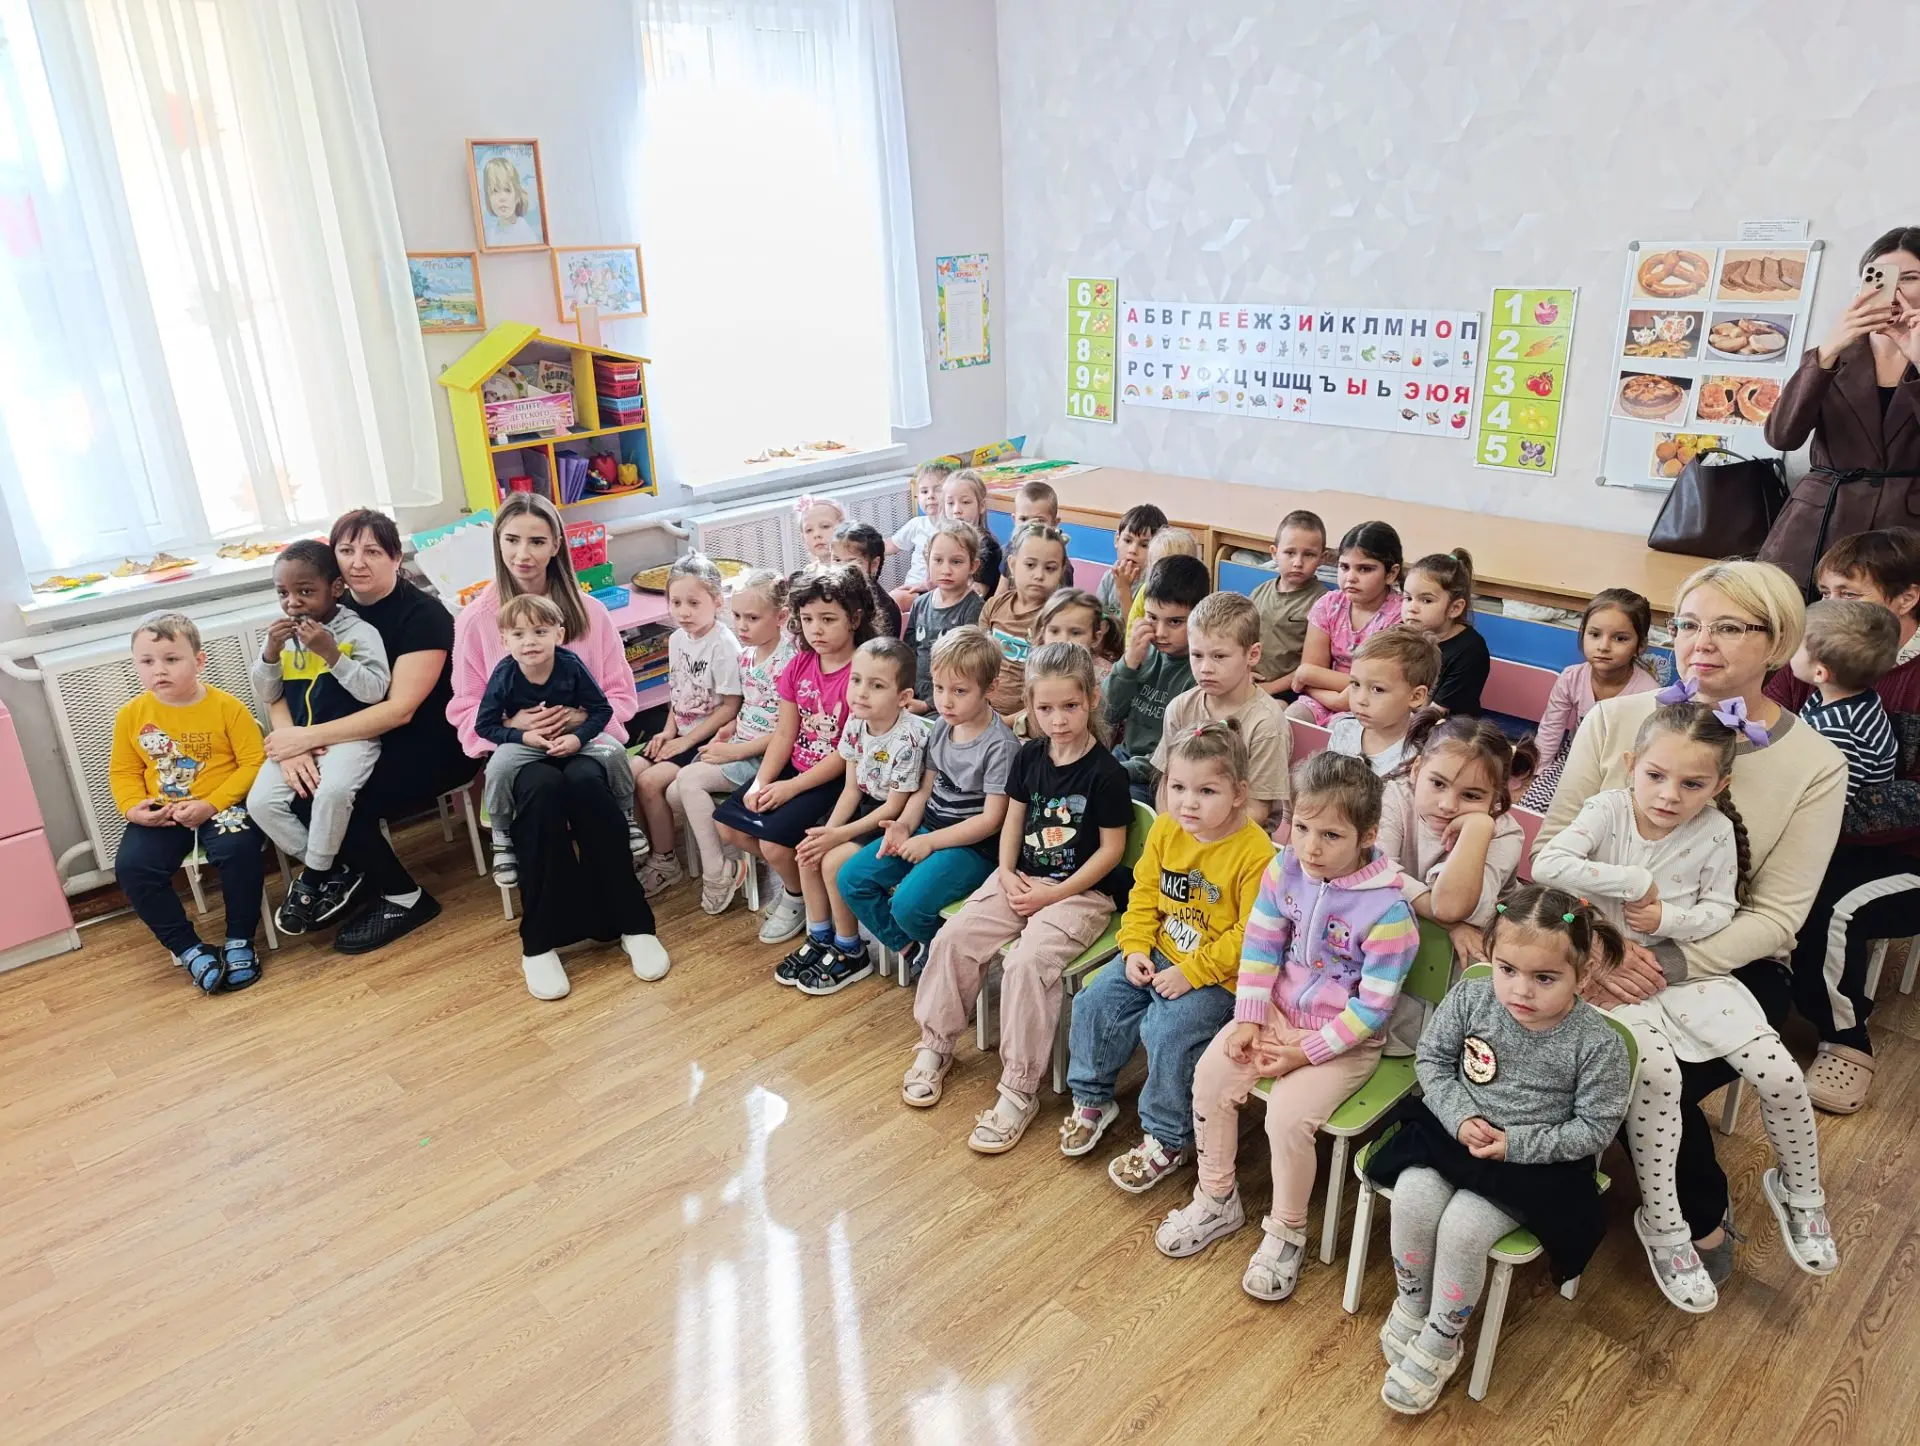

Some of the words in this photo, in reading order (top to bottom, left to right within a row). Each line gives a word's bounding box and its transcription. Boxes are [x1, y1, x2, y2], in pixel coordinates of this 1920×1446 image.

[1077, 282, 1091, 306] 6
[1076, 311, 1092, 334] 7
[1504, 294, 1523, 325] 1
[1127, 308, 1138, 323] А
[1144, 309, 1155, 323] Б
[1162, 309, 1173, 325] В
[1181, 310, 1191, 325] Г
[1198, 311, 1212, 330] Д
[1219, 312, 1229, 328] Е
[1237, 309, 1248, 329] Ё
[1253, 313, 1273, 330] Ж
[1279, 314, 1290, 331] З
[1299, 314, 1312, 332] И
[1320, 312, 1334, 333] Й
[1342, 316, 1355, 334] К
[1362, 317, 1379, 335] Л
[1385, 318, 1403, 336] М
[1411, 319, 1427, 337] Н
[1435, 320, 1452, 339] О
[1461, 321, 1477, 340] П
[1076, 339, 1091, 362] 8
[1495, 329, 1521, 360] 2
[1076, 366, 1090, 389] 9
[1128, 361, 1137, 376] Р
[1144, 362, 1154, 378] С
[1162, 364, 1173, 379] Т
[1180, 365, 1191, 380] У
[1197, 366, 1211, 382] Ф
[1218, 368, 1229, 383] Х
[1234, 369, 1247, 388] Ц
[1254, 371, 1266, 387] Ч
[1273, 372, 1290, 389] Ш
[1292, 374, 1312, 394] Щ
[1319, 375, 1336, 393] Ъ
[1347, 377, 1367, 395] Ы
[1377, 379, 1391, 397] Ь
[1404, 382, 1420, 400] Э
[1426, 383, 1449, 402] Ю
[1452, 386, 1471, 404] Я
[1492, 365, 1515, 396] 3
[515, 402, 541, 412] ЦЕНТР
[1069, 393, 1096, 416] 10
[1487, 401, 1511, 431] 4
[1483, 435, 1508, 464] 5
[181, 732, 212, 743] BEST
[184, 743, 212, 753] PUPS
[1161, 870, 1187, 899] MAKE
